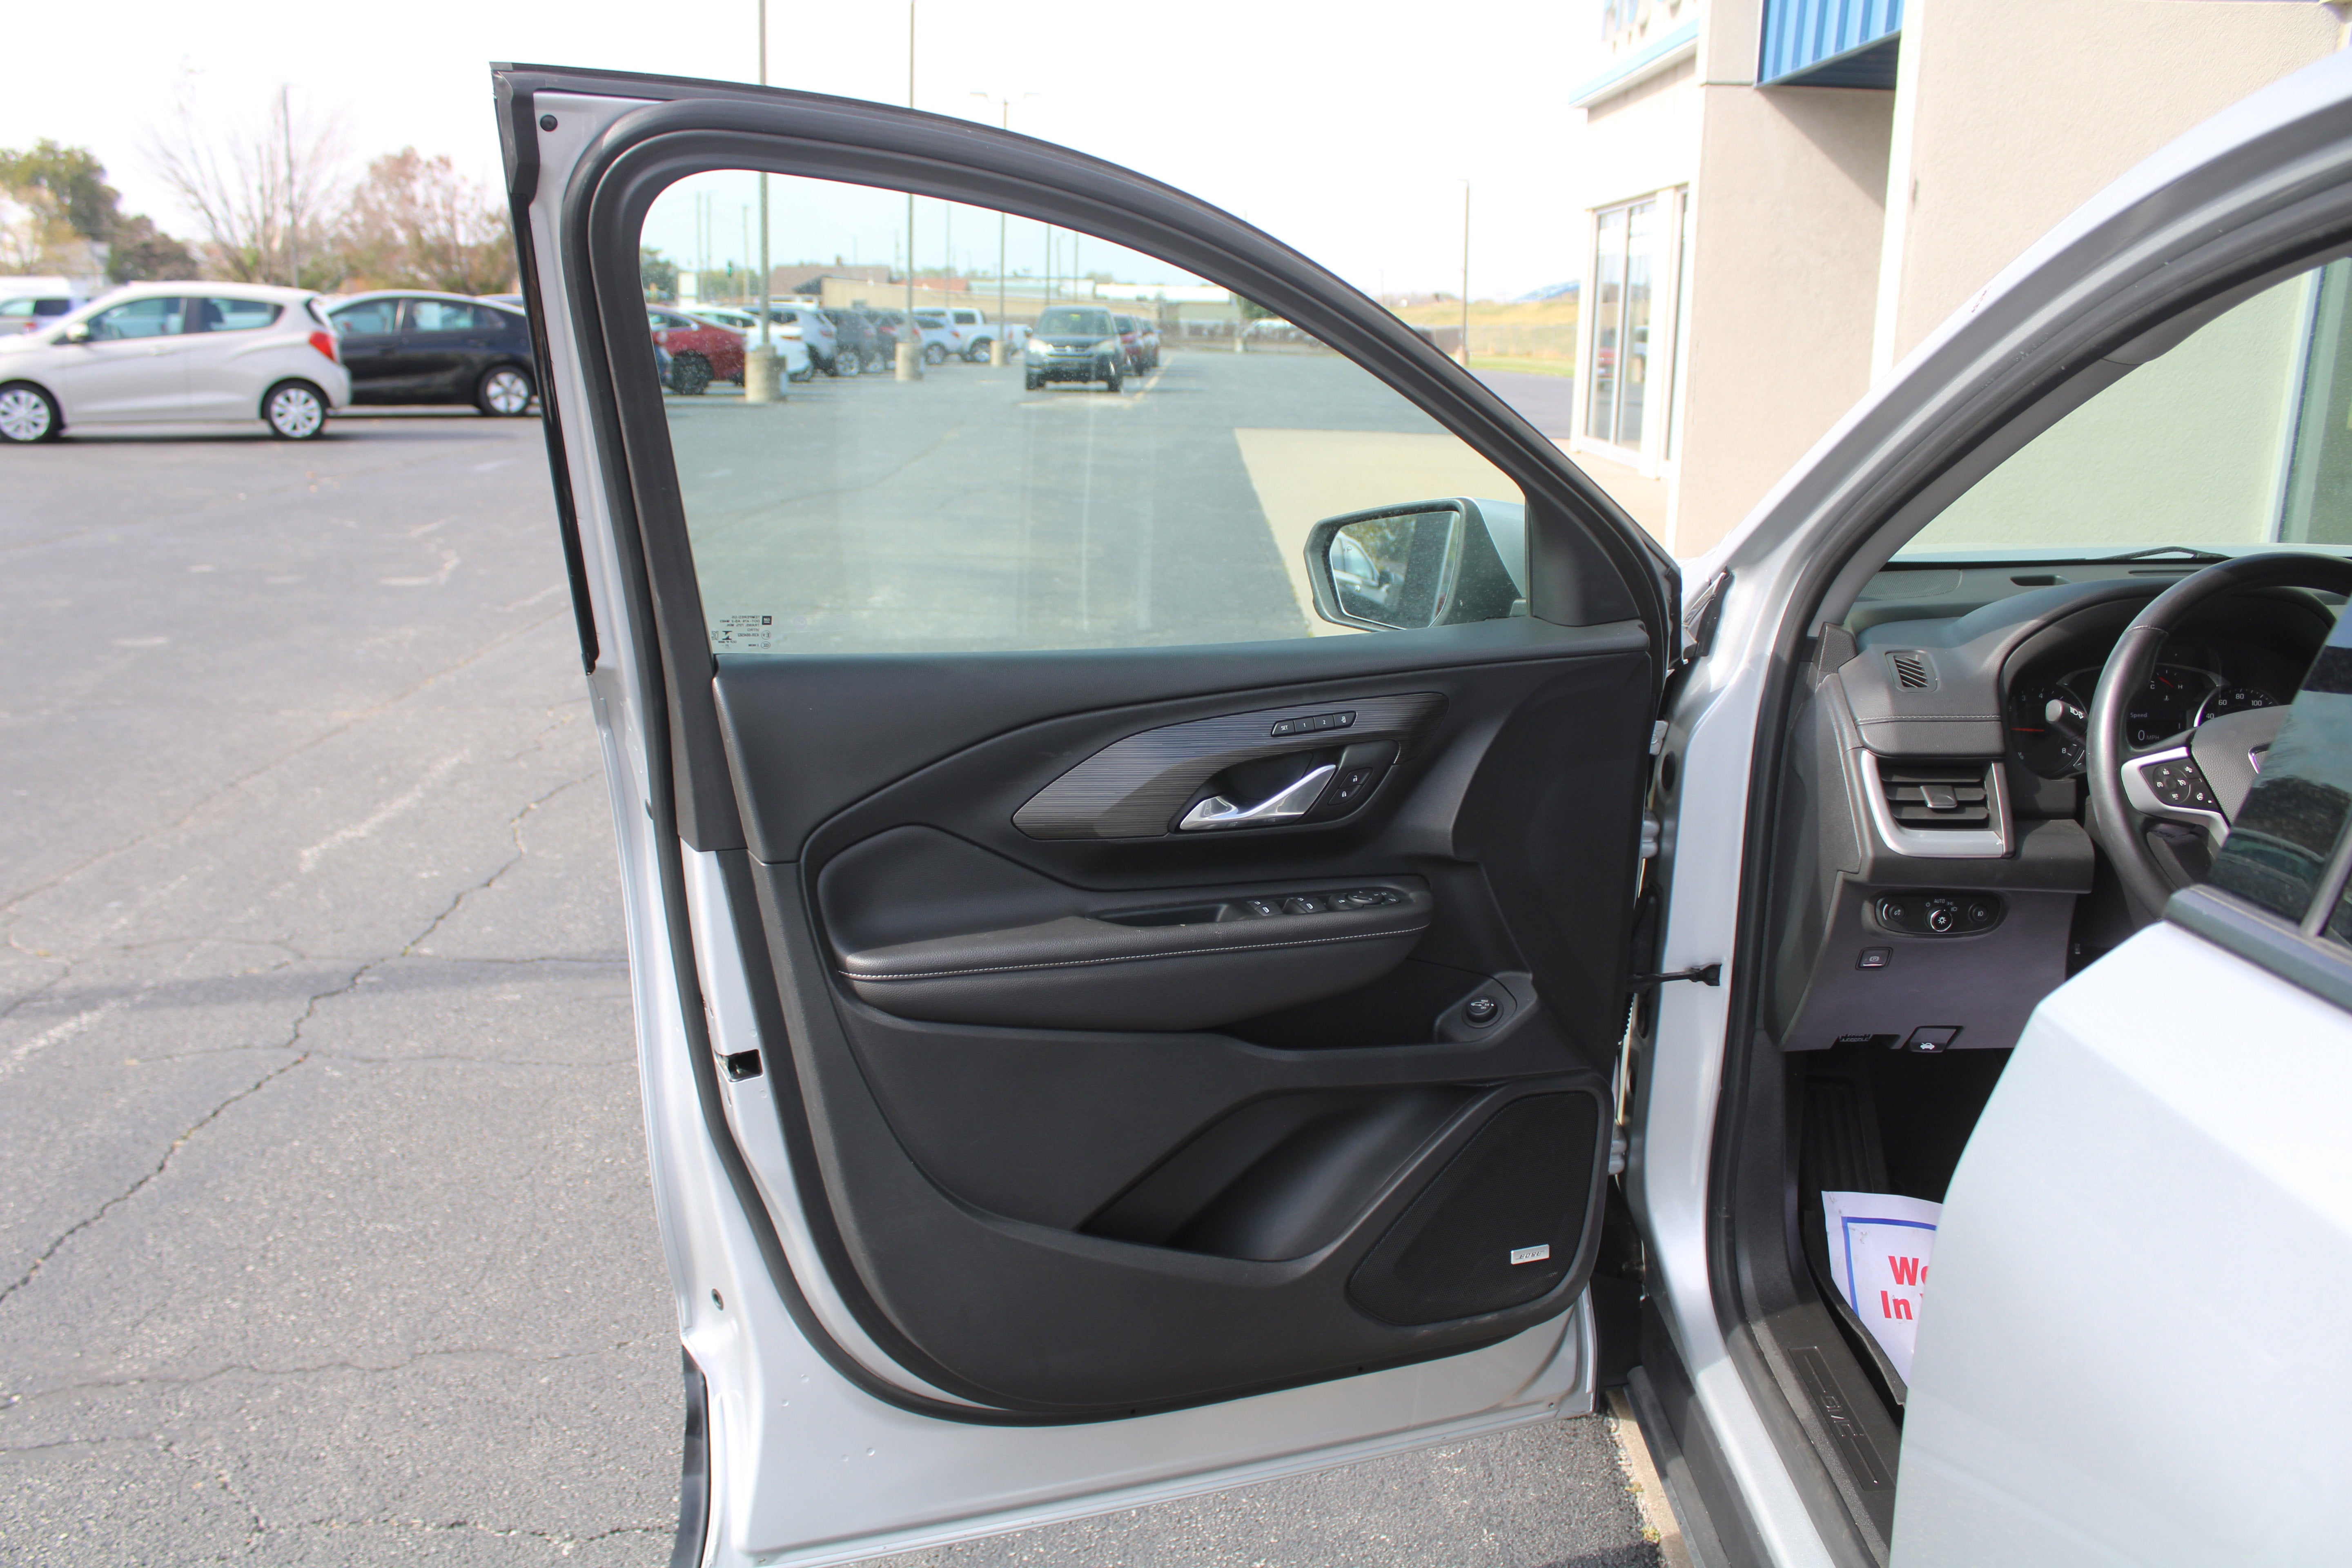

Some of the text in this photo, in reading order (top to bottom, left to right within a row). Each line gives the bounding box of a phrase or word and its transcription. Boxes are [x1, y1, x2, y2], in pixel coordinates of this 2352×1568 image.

[2138, 730, 2145, 741] 0
[1517, 1251, 1543, 1259] BOSE
[1880, 1290, 1913, 1320] In
[1821, 1396, 1858, 1437] GMC
